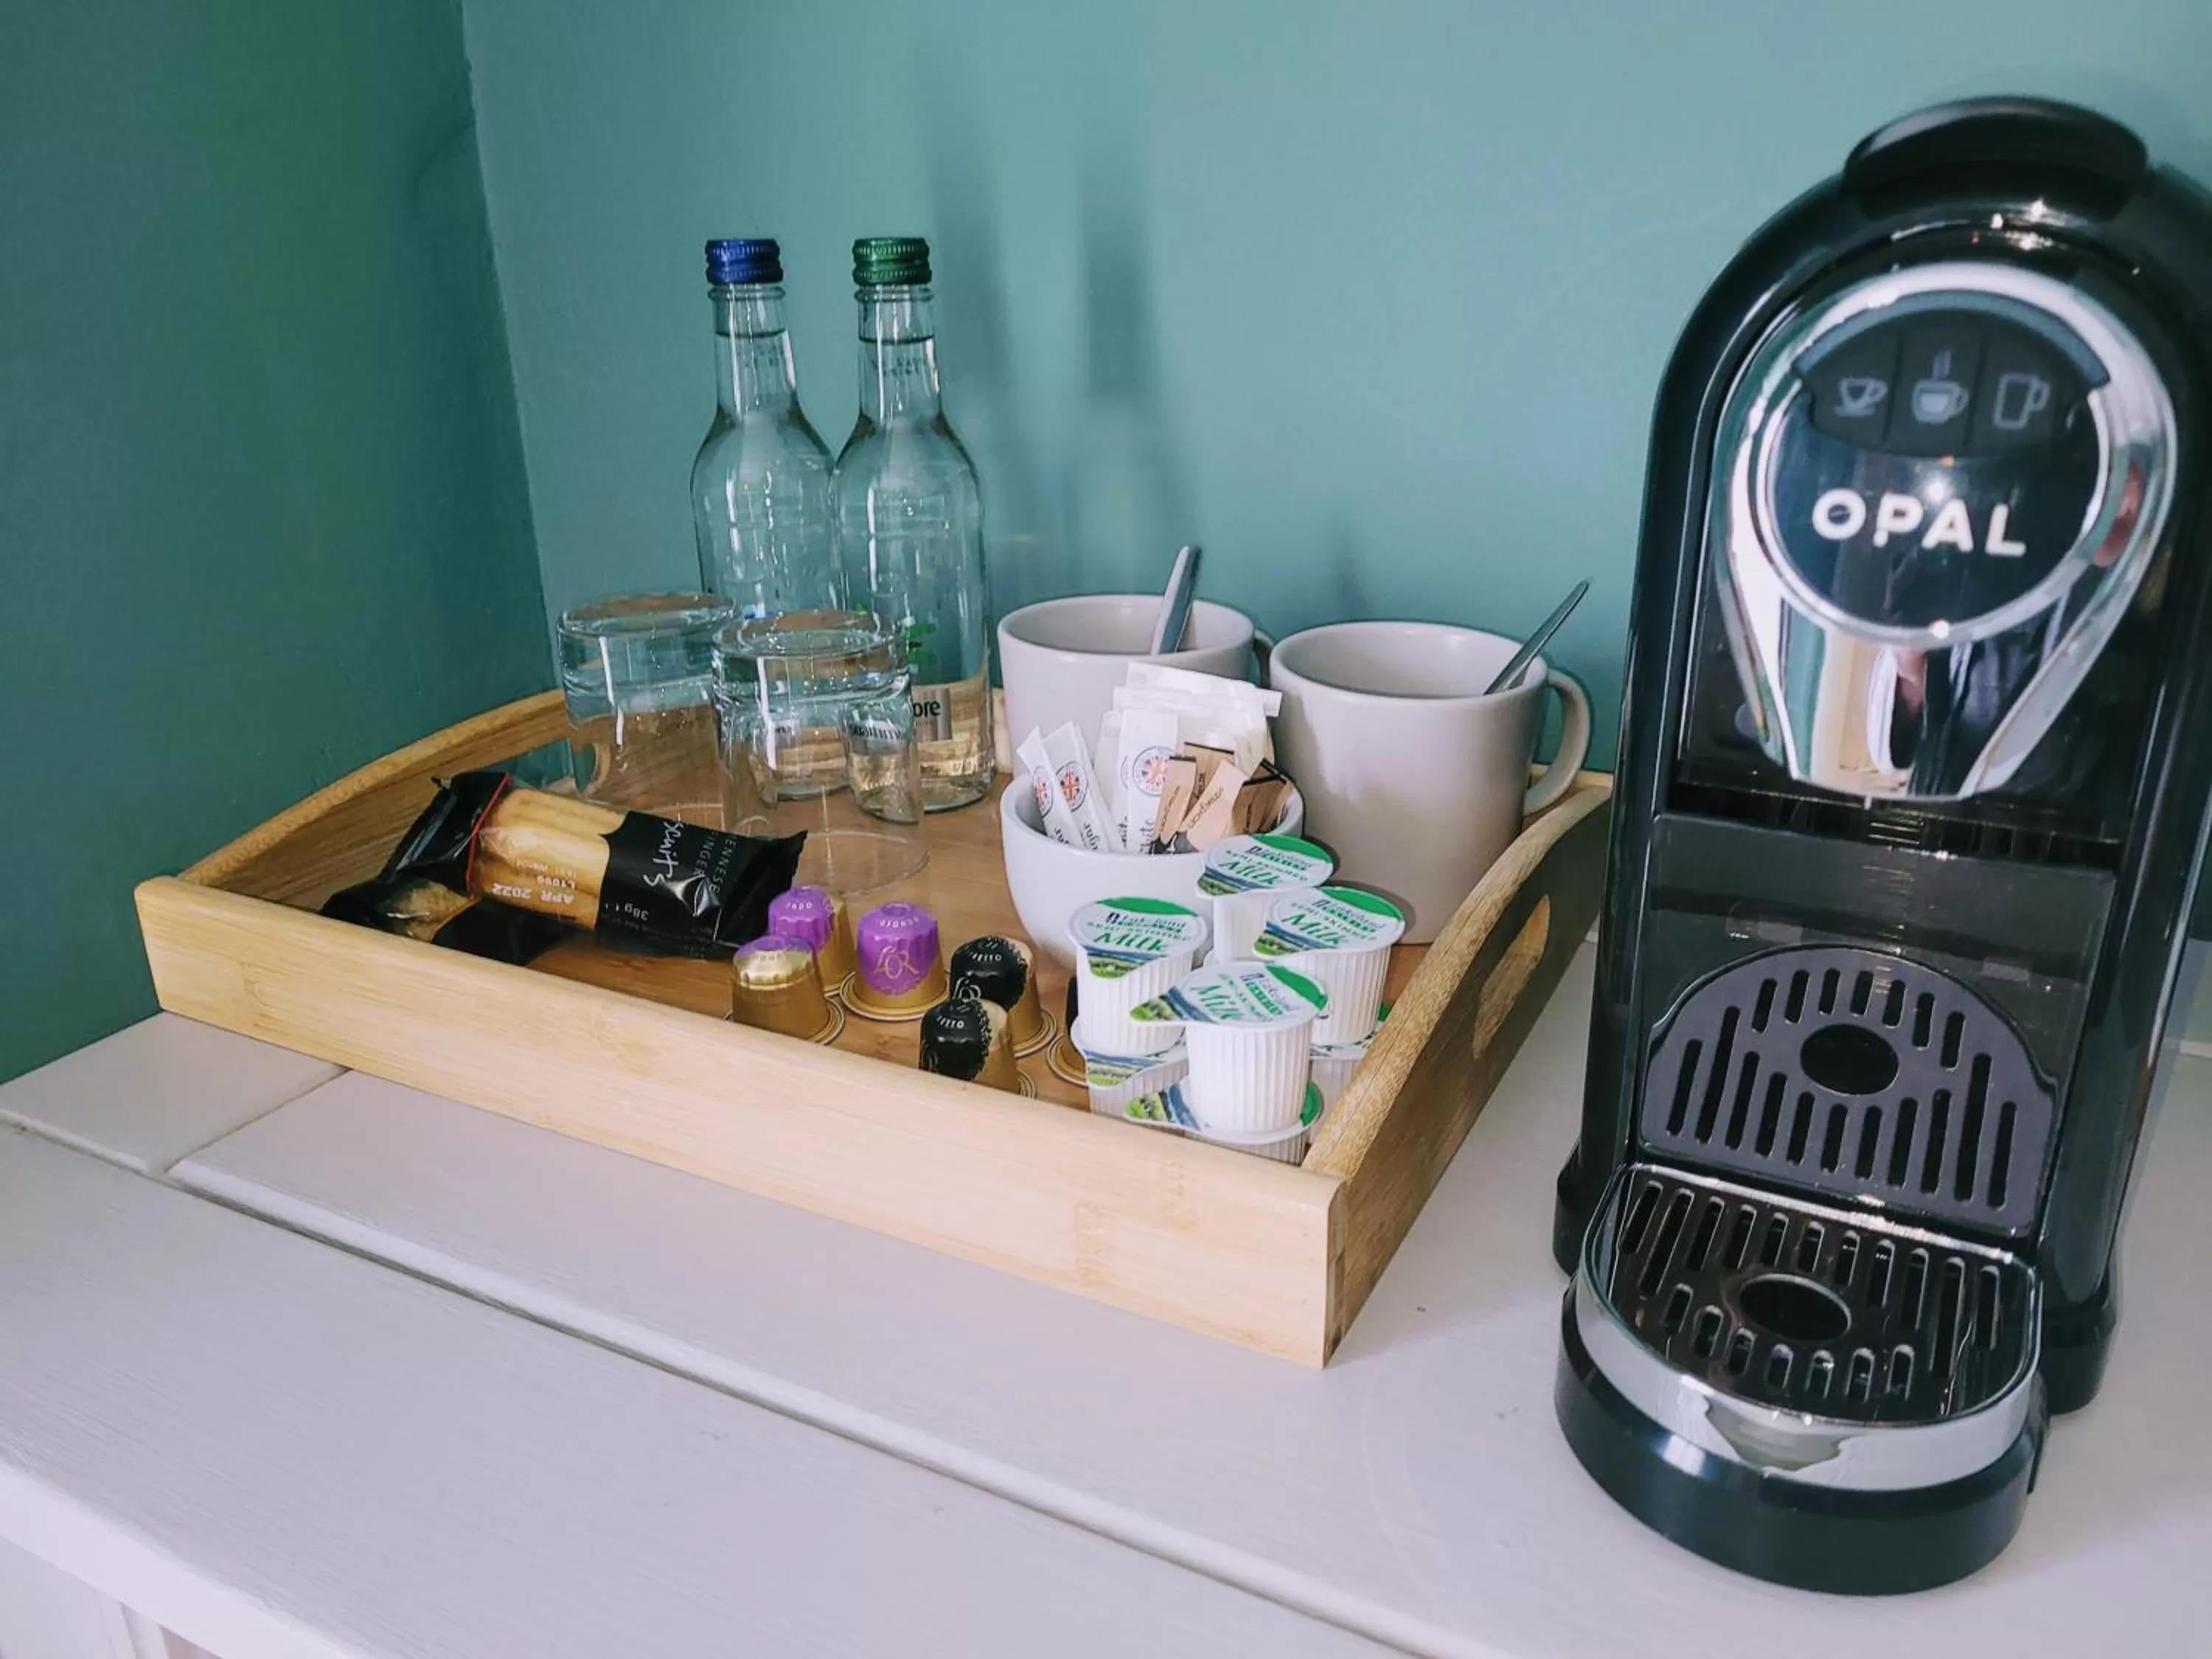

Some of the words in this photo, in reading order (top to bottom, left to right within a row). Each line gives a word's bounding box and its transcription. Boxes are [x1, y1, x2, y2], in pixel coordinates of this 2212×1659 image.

[1812, 488, 2027, 557] OPAL
[493, 883, 532, 900] 2022
[540, 890, 574, 905] APR
